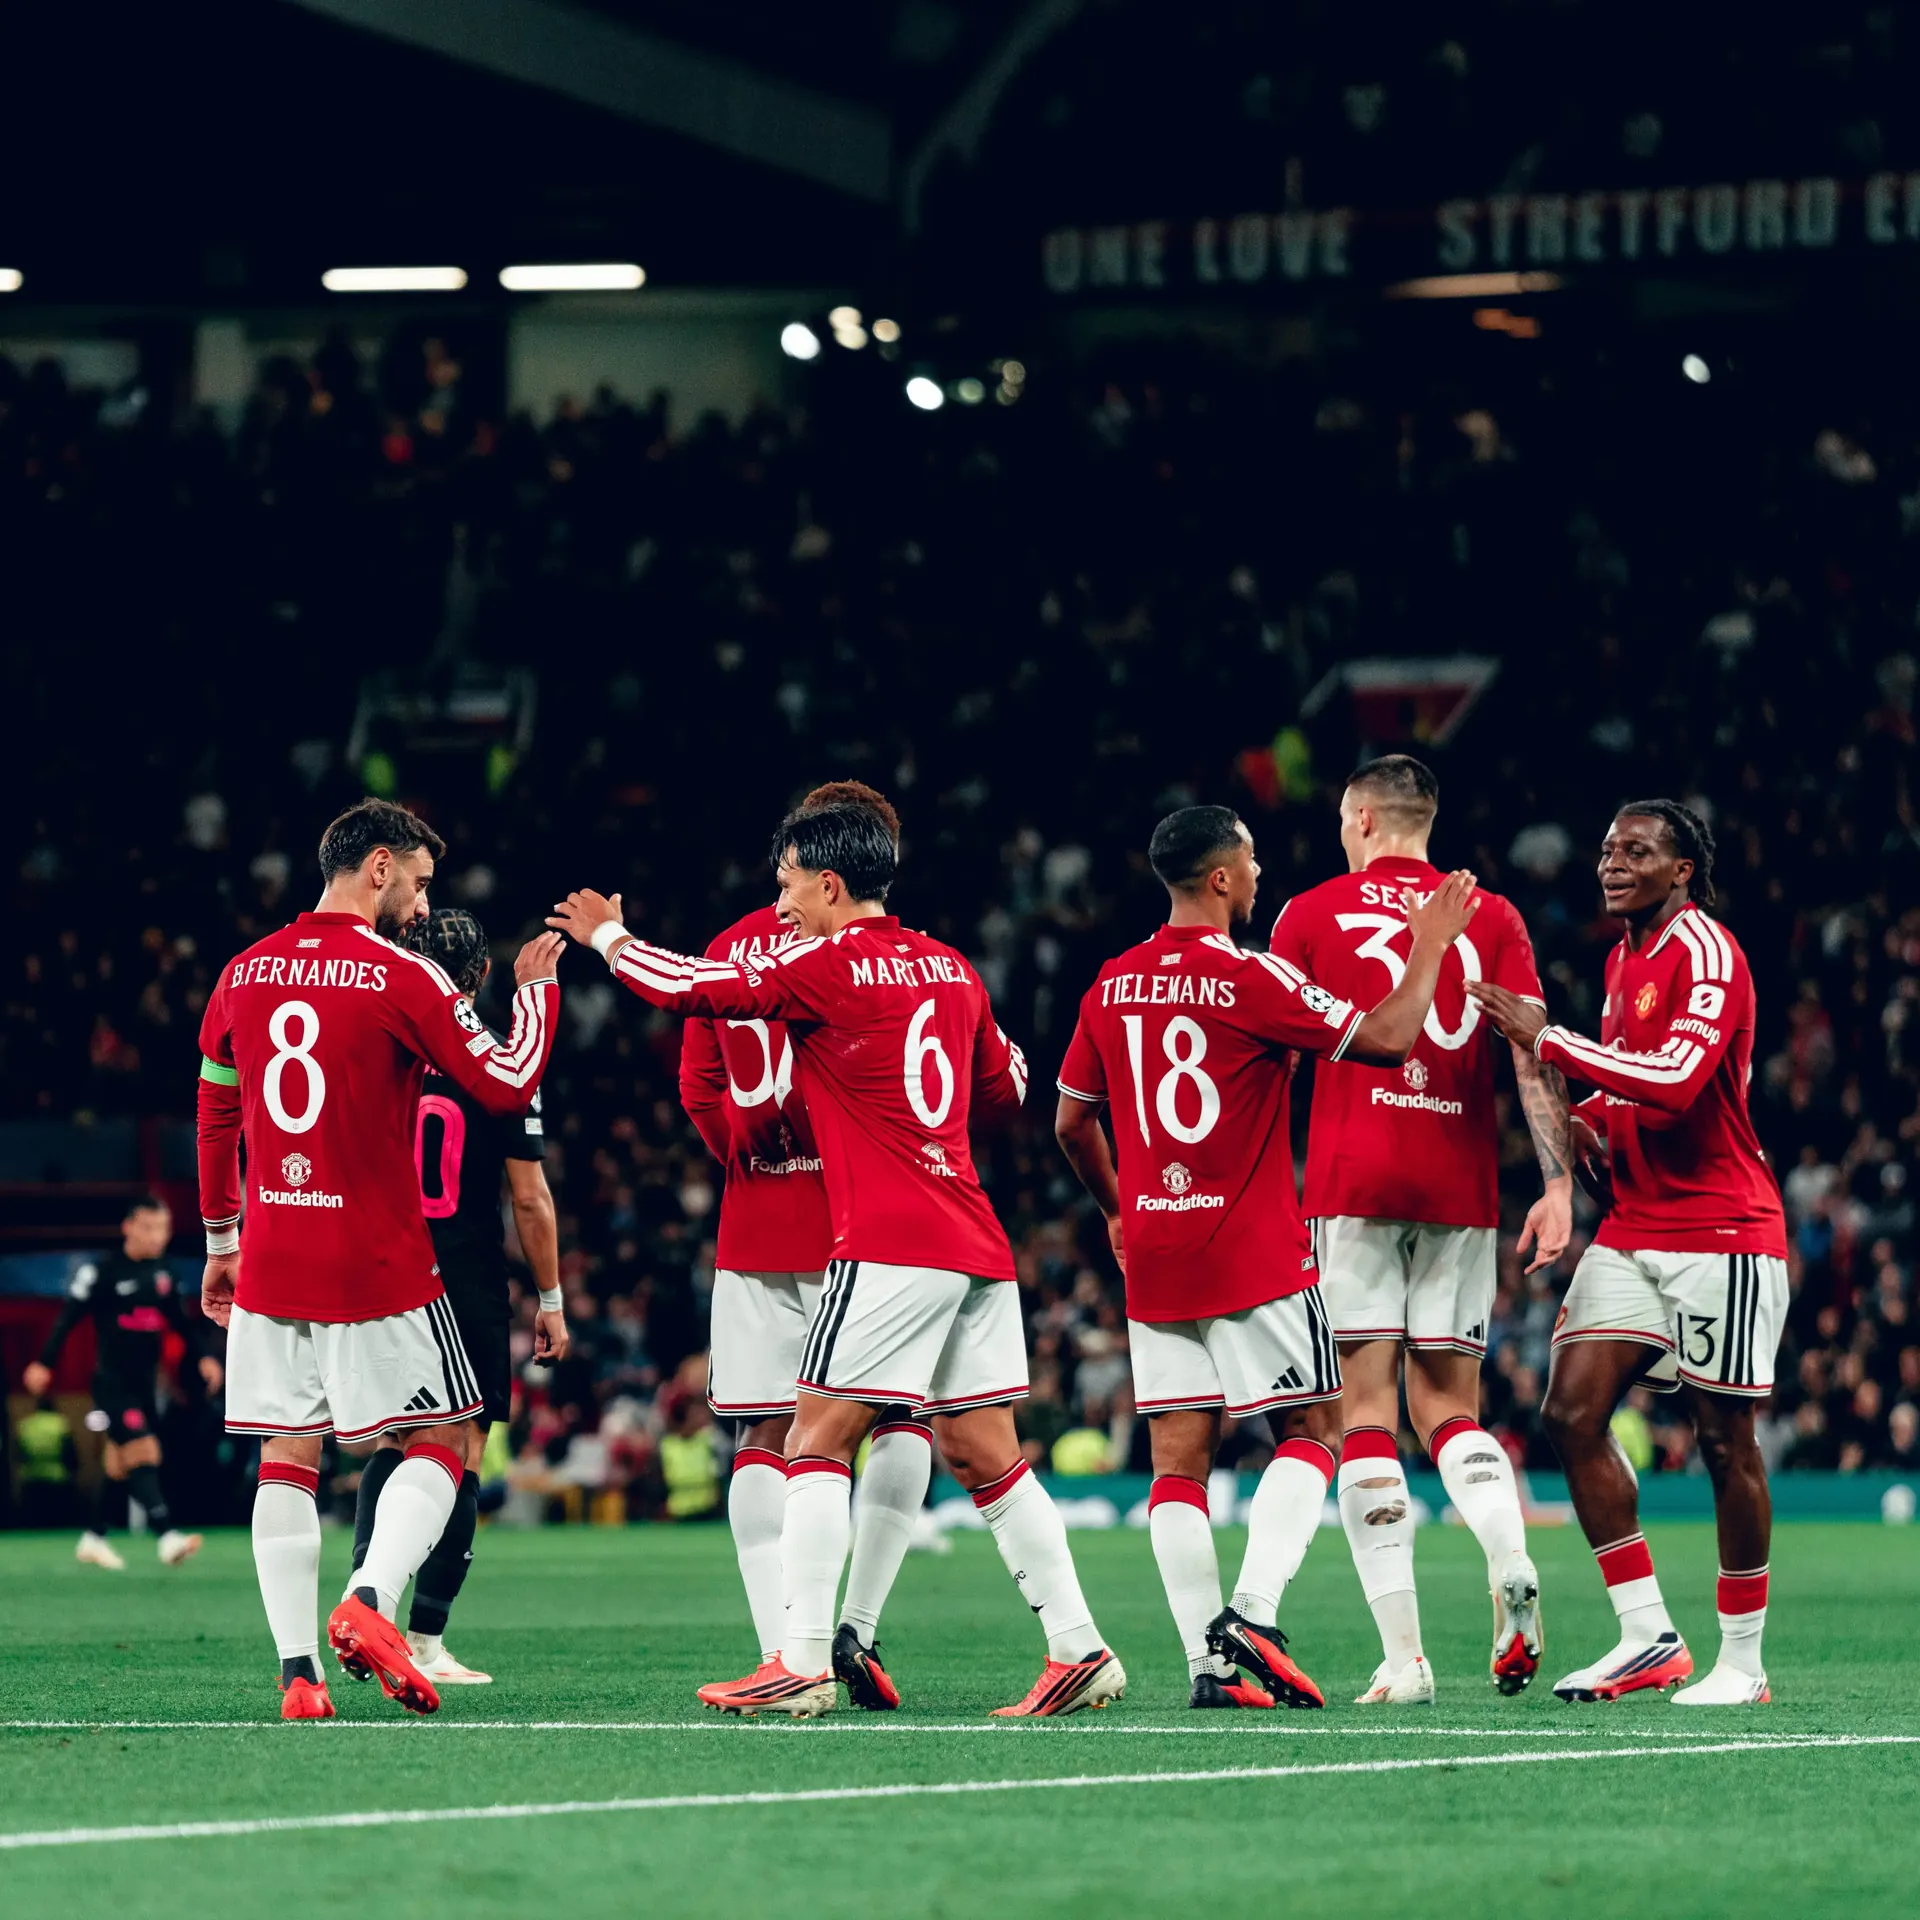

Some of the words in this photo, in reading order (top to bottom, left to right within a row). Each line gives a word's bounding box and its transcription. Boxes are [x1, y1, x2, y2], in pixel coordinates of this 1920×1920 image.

[1195, 209, 1352, 284] LOVE
[1437, 178, 1838, 268] STRETFORD
[728, 931, 799, 963] MAIN
[230, 956, 388, 992] B.FERNANDES
[1102, 973, 1235, 1007] TIELEMANS
[263, 1000, 326, 1134] 8
[905, 998, 954, 1128] 6
[1121, 1015, 1220, 1148] 18
[1372, 1087, 1462, 1114] Foundation
[750, 1156, 823, 1174] Founation
[1136, 1193, 1224, 1211] Foundation
[1677, 1312, 1718, 1367] 13
